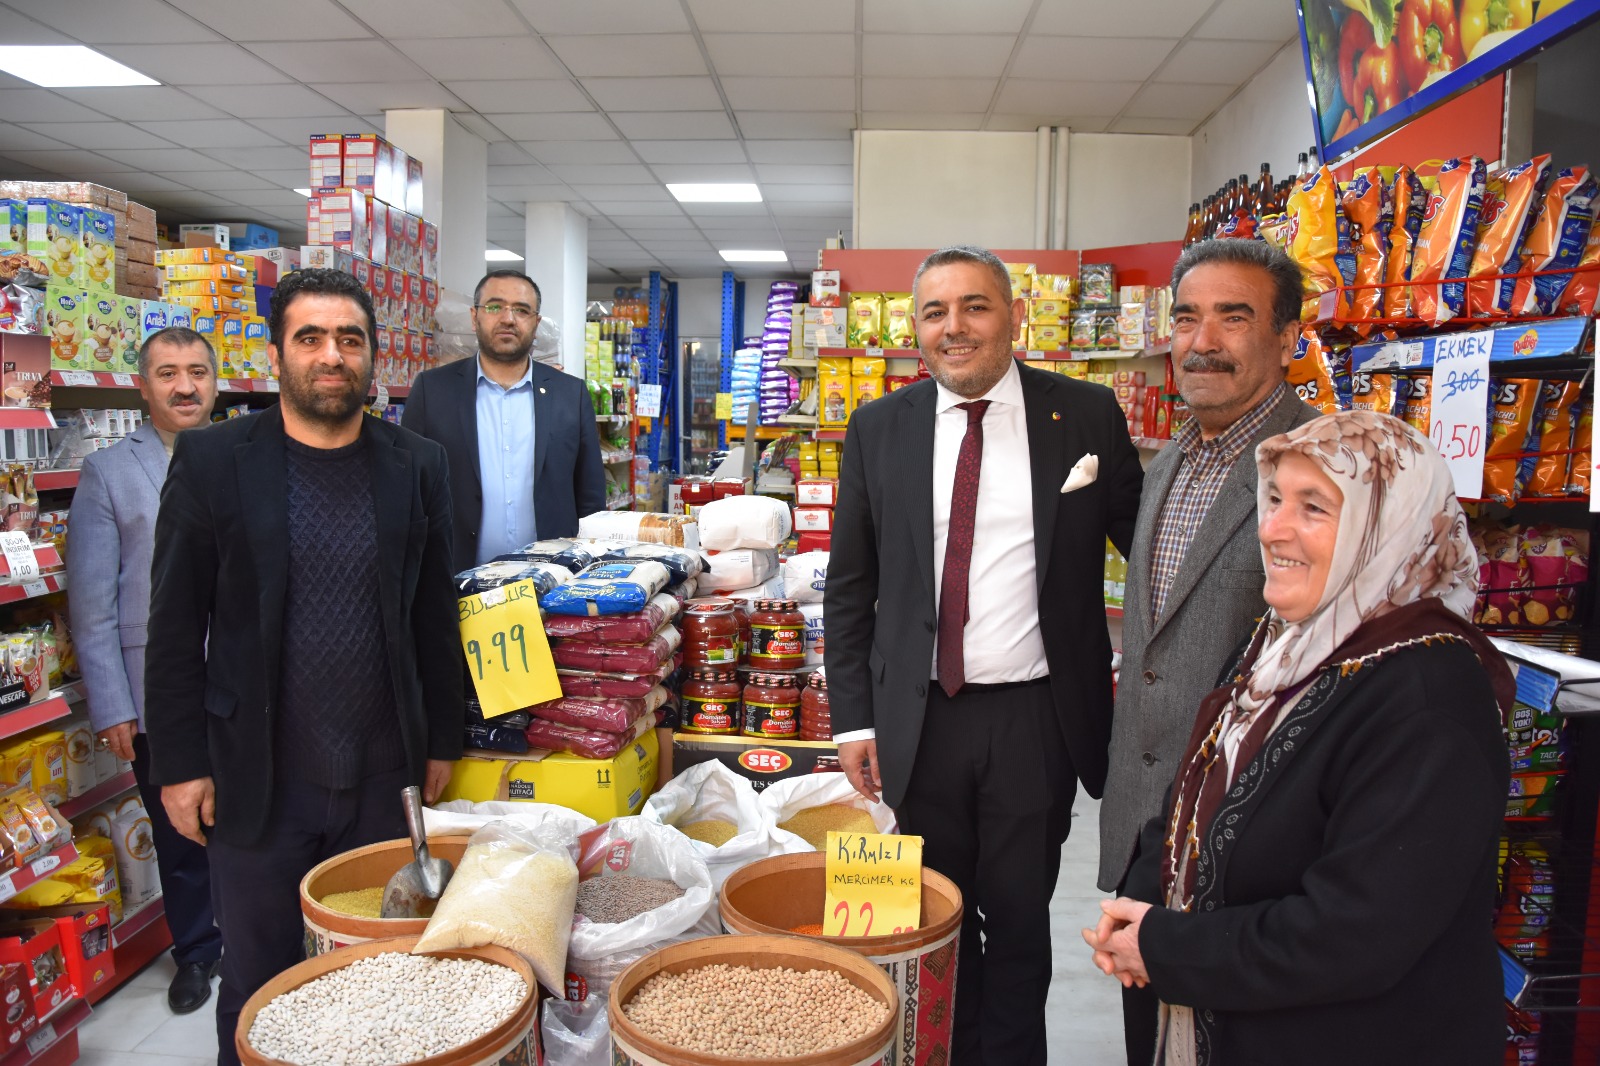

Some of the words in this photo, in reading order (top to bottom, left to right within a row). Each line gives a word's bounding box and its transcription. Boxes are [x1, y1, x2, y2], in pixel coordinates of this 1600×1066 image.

[224, 321, 237, 335] ARI
[249, 324, 261, 336] ARI
[1436, 336, 1486, 363] EKMEK
[467, 624, 529, 680] 9.99
[1515, 710, 1530, 718] BOŞ
[748, 754, 780, 770] SEÇ
